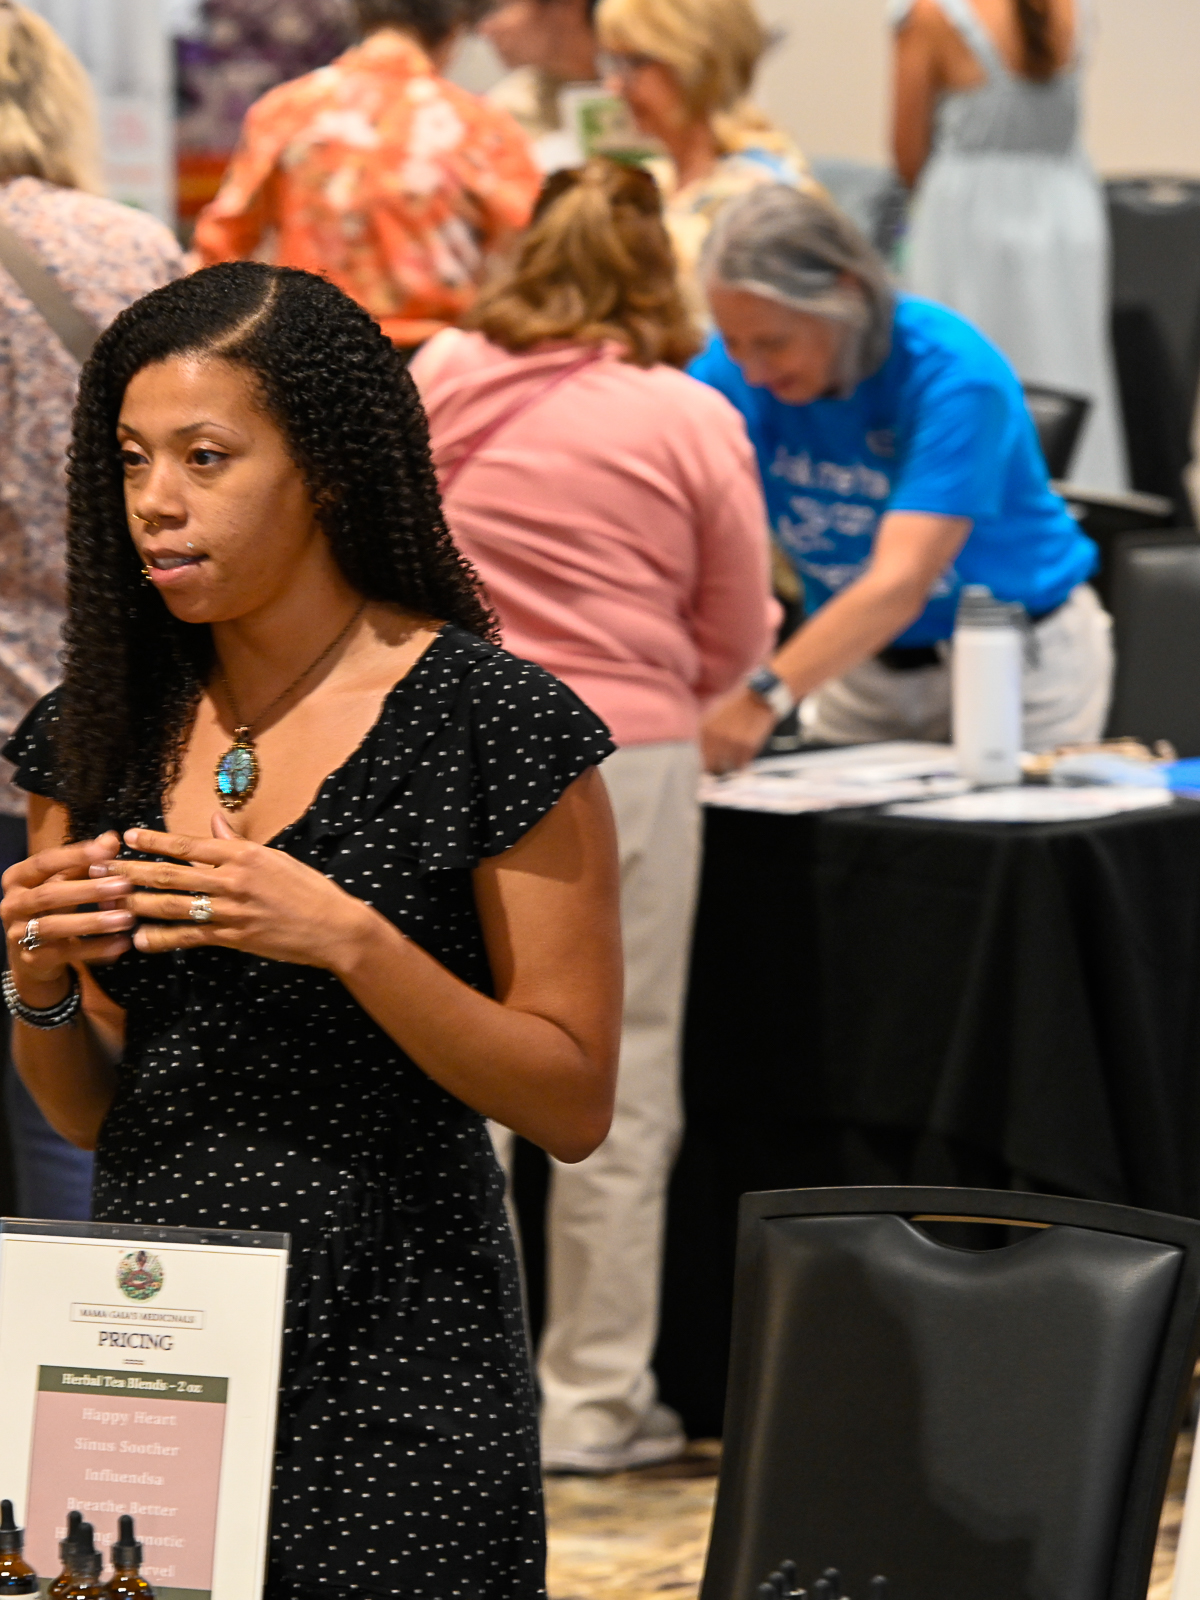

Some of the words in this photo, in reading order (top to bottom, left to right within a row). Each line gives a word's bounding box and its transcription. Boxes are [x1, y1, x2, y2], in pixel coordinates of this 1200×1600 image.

[80, 1309, 107, 1318] MAMA
[140, 1312, 195, 1323] MEDICINALS
[98, 1331, 174, 1351] PRICING
[62, 1373, 103, 1387] Herbal
[104, 1375, 126, 1388] Tea
[127, 1377, 168, 1391] Blends
[177, 1381, 187, 1393] 2
[82, 1408, 129, 1426] Happy
[133, 1411, 177, 1426] Heart
[74, 1437, 115, 1452] Sinus
[119, 1440, 180, 1456] Soother
[67, 1497, 127, 1514] Breathe
[129, 1501, 179, 1517] Better
[138, 1564, 177, 1578] arvel
